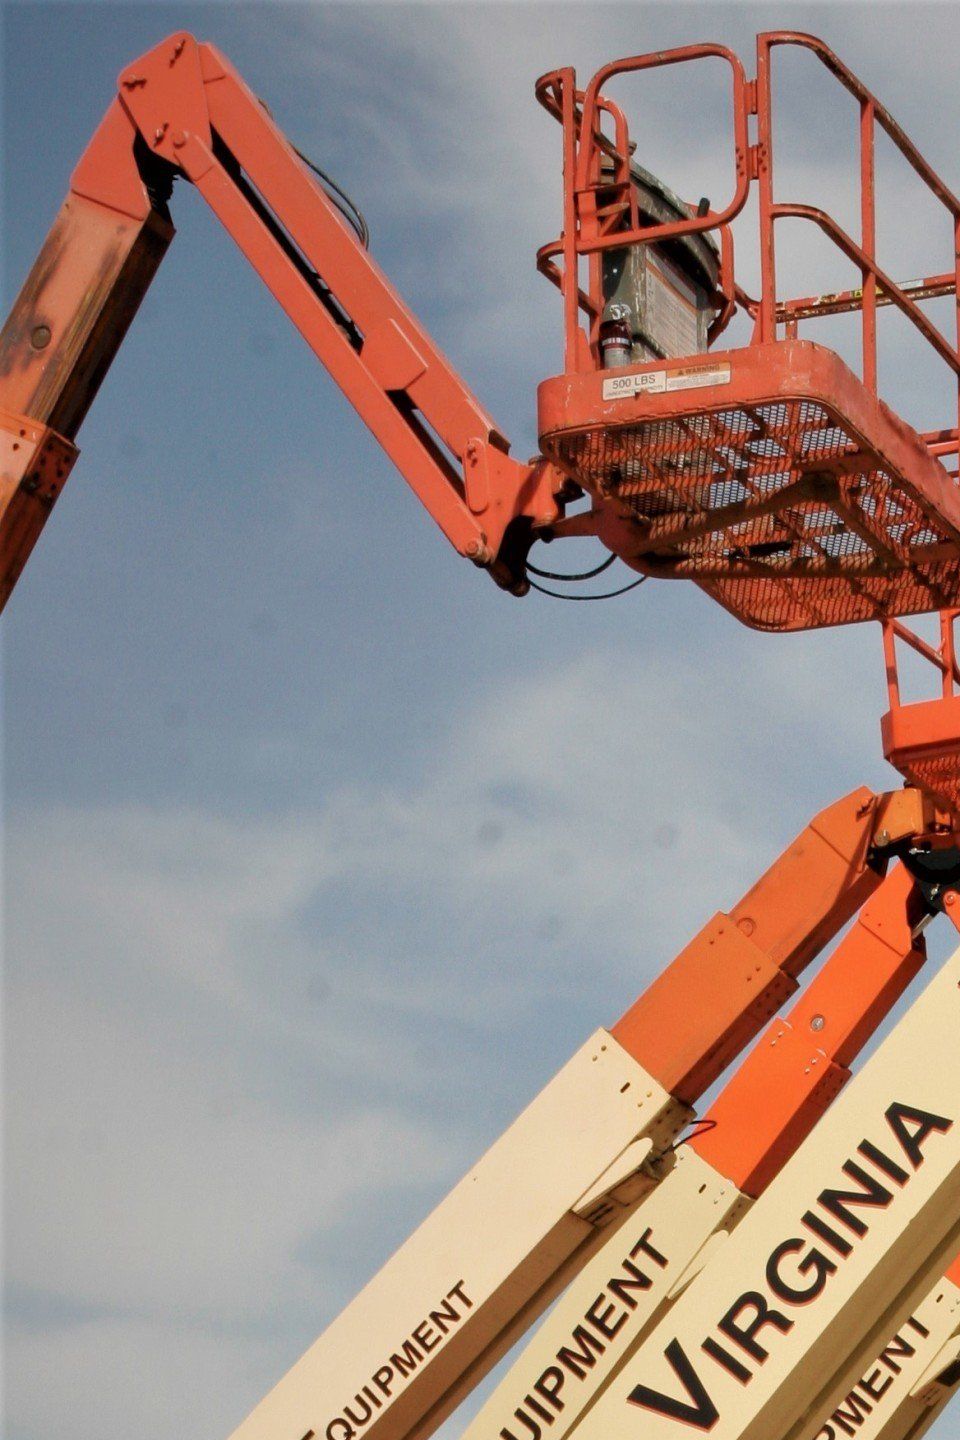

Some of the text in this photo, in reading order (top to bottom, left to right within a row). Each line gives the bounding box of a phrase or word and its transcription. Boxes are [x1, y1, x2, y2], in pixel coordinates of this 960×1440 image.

[612, 379, 631, 389] 500
[634, 374, 656, 386] LBS
[628, 1101, 953, 1432] VIRGINIA
